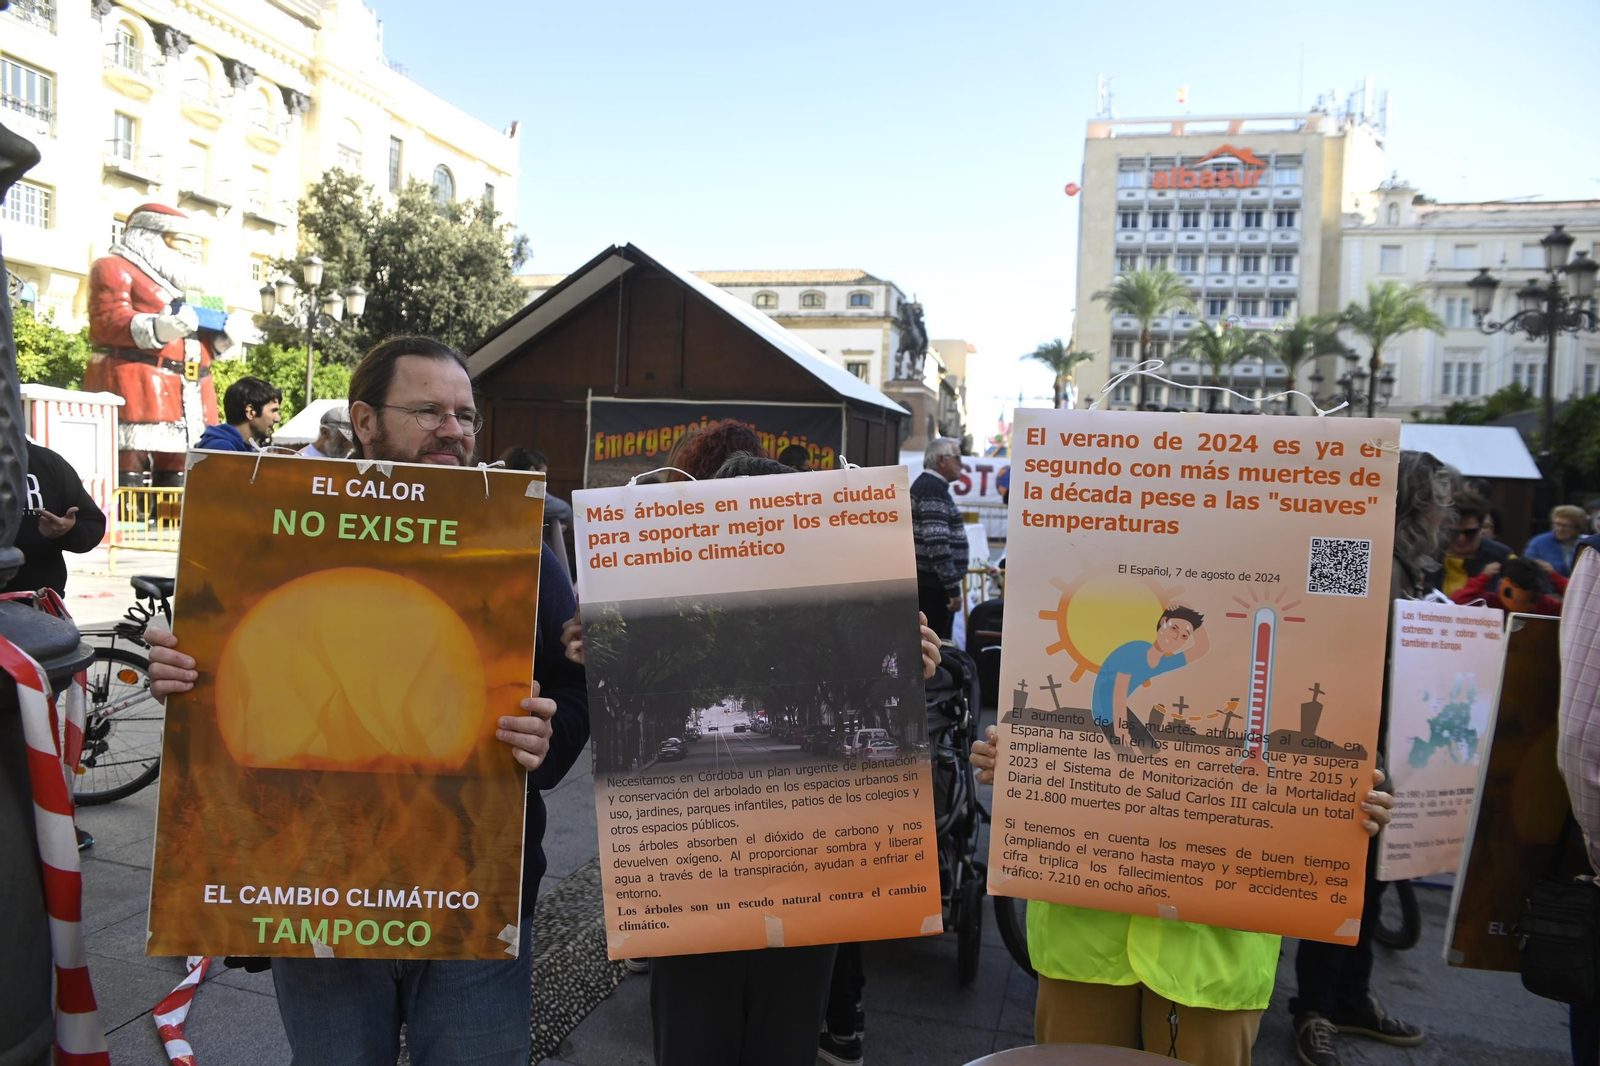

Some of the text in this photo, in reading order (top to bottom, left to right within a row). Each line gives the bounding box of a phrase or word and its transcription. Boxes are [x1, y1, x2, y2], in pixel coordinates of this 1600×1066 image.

[1152, 167, 1266, 188] albasur
[594, 416, 719, 461] Emergen
[1026, 427, 1046, 446] El
[1059, 432, 1140, 449] verano
[1153, 431, 1183, 451] de
[1197, 432, 1258, 453] 2024
[1273, 439, 1300, 455] es
[1315, 441, 1344, 460] ya
[1024, 456, 1381, 487] segundo con más muertes de
[312, 476, 425, 502] EL CALOR
[586, 483, 896, 523] Más árboles en nuestra ciudad
[1023, 481, 1378, 515] la década pese a las "suaves"
[272, 509, 459, 546] NO EXISTE
[588, 509, 899, 550] para soportar mejor los efectos
[1021, 509, 1179, 534] temperaturas
[589, 540, 785, 569] del cambio climático
[1117, 563, 1280, 583] El Español, 7 de agosto de 2024
[1008, 754, 1356, 803] 2023 el Sistema de Monitorización de la Mortalidad
[1009, 741, 1358, 788] ampliamente las muertes en carretera. Entre 2015 y
[609, 787, 919, 821] uso, jardines, parques infantiles, patios de los colegios y
[1006, 786, 1273, 829] de 21.800 muertes por altas temperaturas.
[611, 821, 922, 853] Los árboles absorben el dióxido de carbono y nos
[612, 836, 923, 869] devuelven oxígeno. Al proporcionar sombra y liberar
[1004, 817, 1350, 872] Si tenemos en cuenta los meses de buen tiempo
[1004, 832, 1348, 887] (ampliando el verano hasta mayo y septiembre), esa
[615, 888, 661, 899] entorno.
[1001, 864, 1170, 899] tráfico: 7.210 en ocho años.
[1002, 849, 1347, 905] cifra triplica los fallecimientos por accidentes de
[203, 884, 480, 910] EL CAMBIO CLIMÁTICO
[617, 883, 927, 916] Los árboles son un escudo natural contra el cambio
[252, 917, 432, 947] TAMPOCO
[618, 919, 669, 931] climático.
